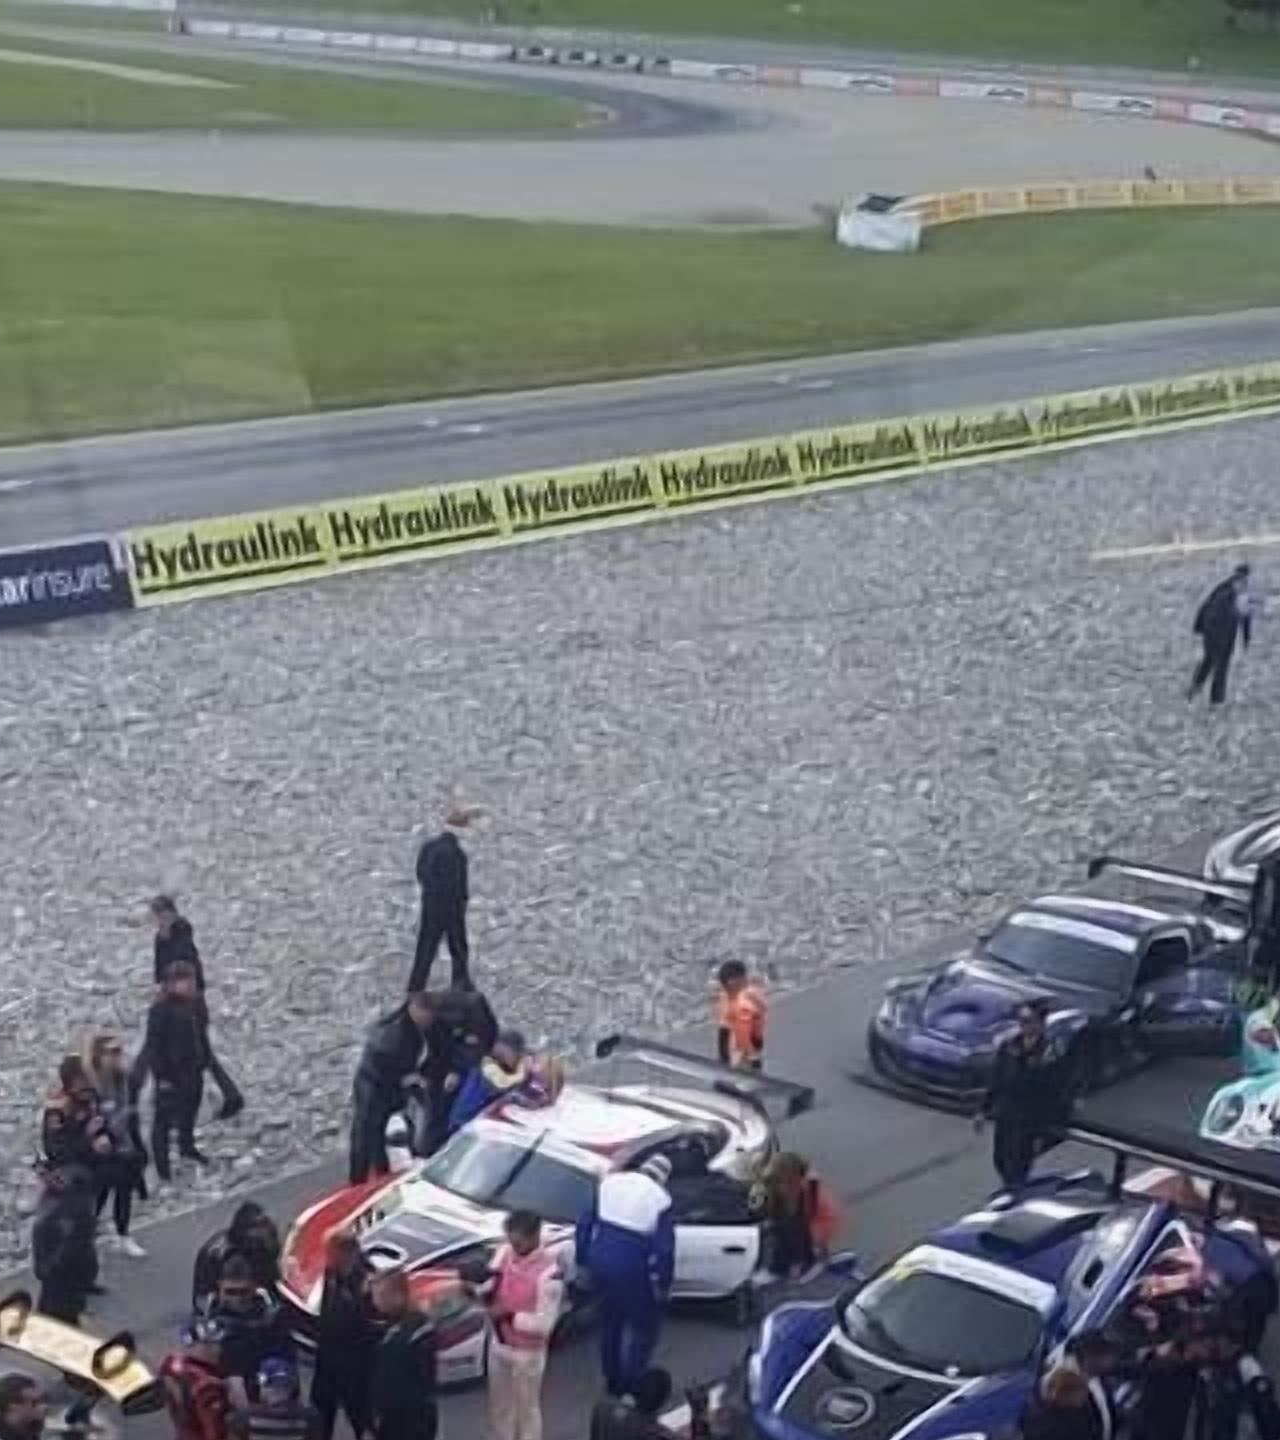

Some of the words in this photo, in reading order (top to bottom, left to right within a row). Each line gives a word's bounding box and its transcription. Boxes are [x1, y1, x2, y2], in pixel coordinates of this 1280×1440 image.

[505, 466, 652, 519] Hydraulink
[658, 446, 790, 494] Hydraulink
[330, 491, 494, 548] Hydraulink
[132, 520, 321, 580] Hydraulink
